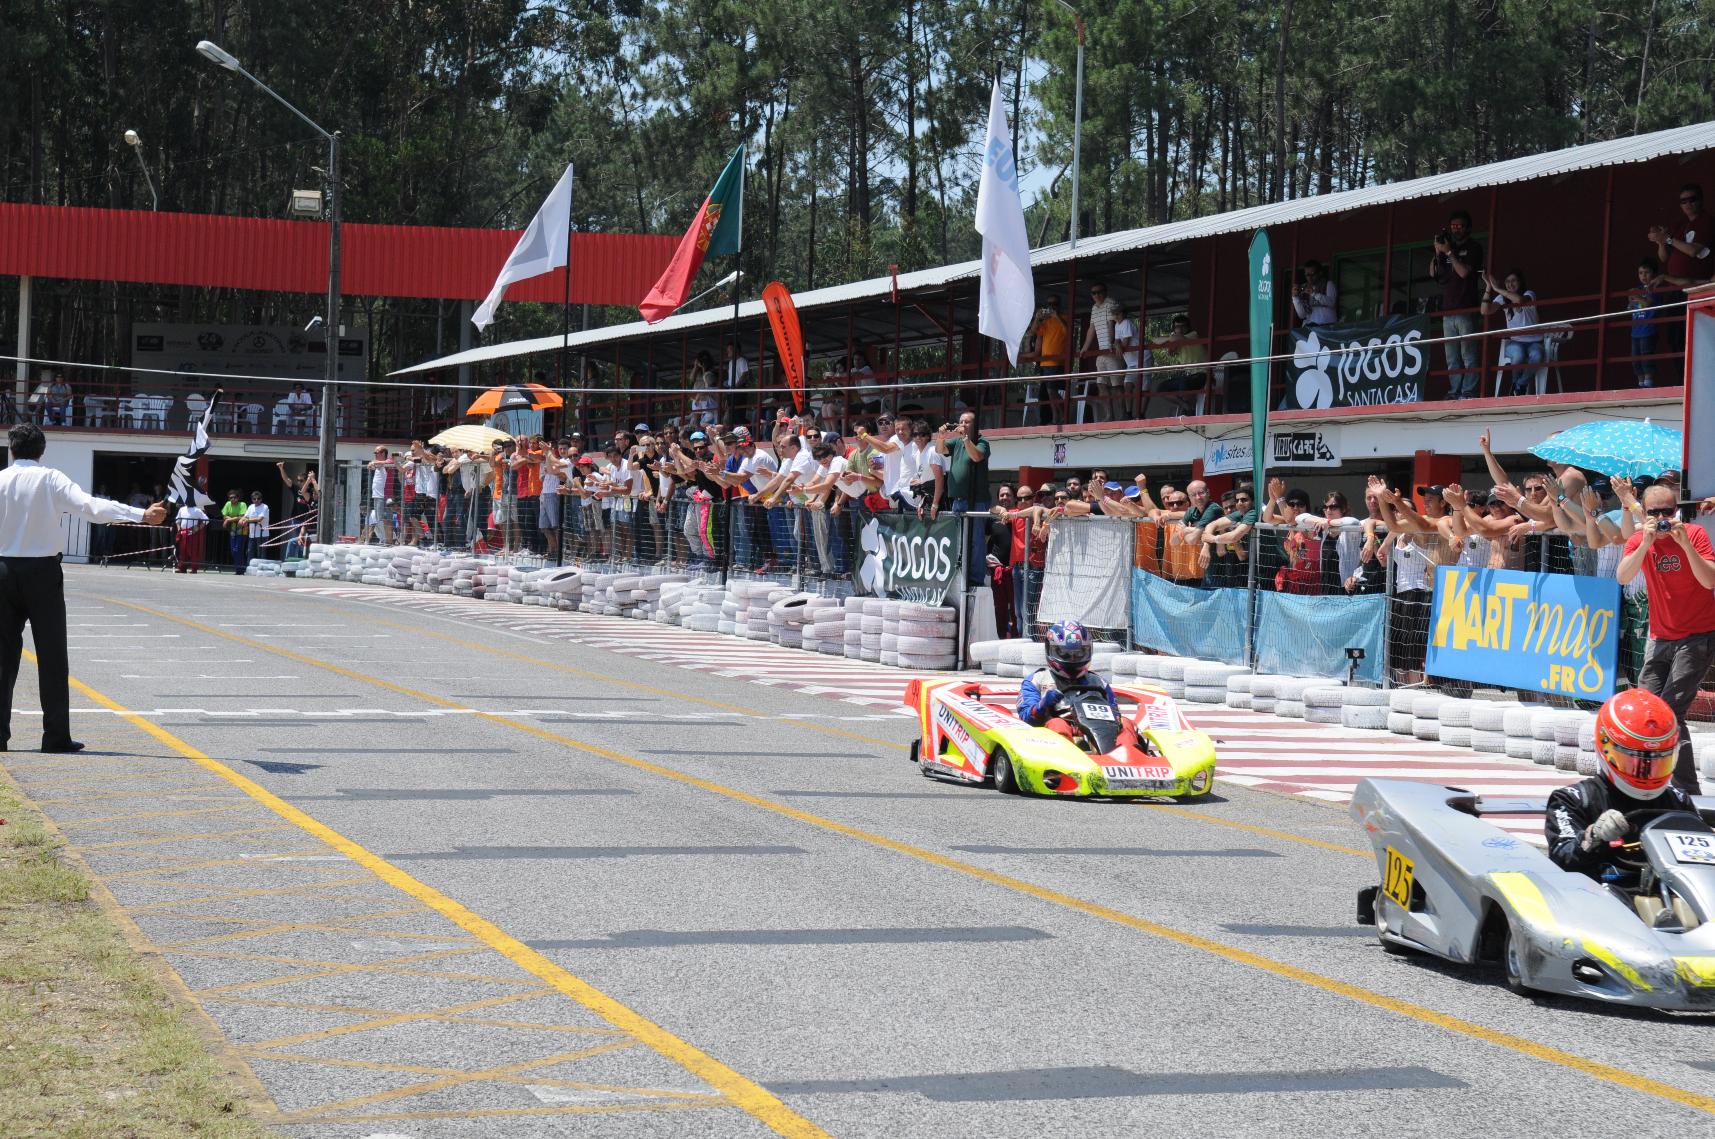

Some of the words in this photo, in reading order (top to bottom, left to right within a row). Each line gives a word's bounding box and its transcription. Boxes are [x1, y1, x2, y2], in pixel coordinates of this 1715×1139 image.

[1338, 329, 1422, 400] JOGOS
[888, 534, 951, 591] JOGOS
[1653, 552, 1681, 572] Lee
[1433, 570, 1529, 650] KART
[1522, 602, 1614, 693] mag
[938, 704, 970, 744] UNITRIP
[1087, 704, 1108, 713] 99
[1106, 766, 1171, 779] UNITRIP
[1677, 835, 1710, 848] 125
[1383, 850, 1413, 907] 125
